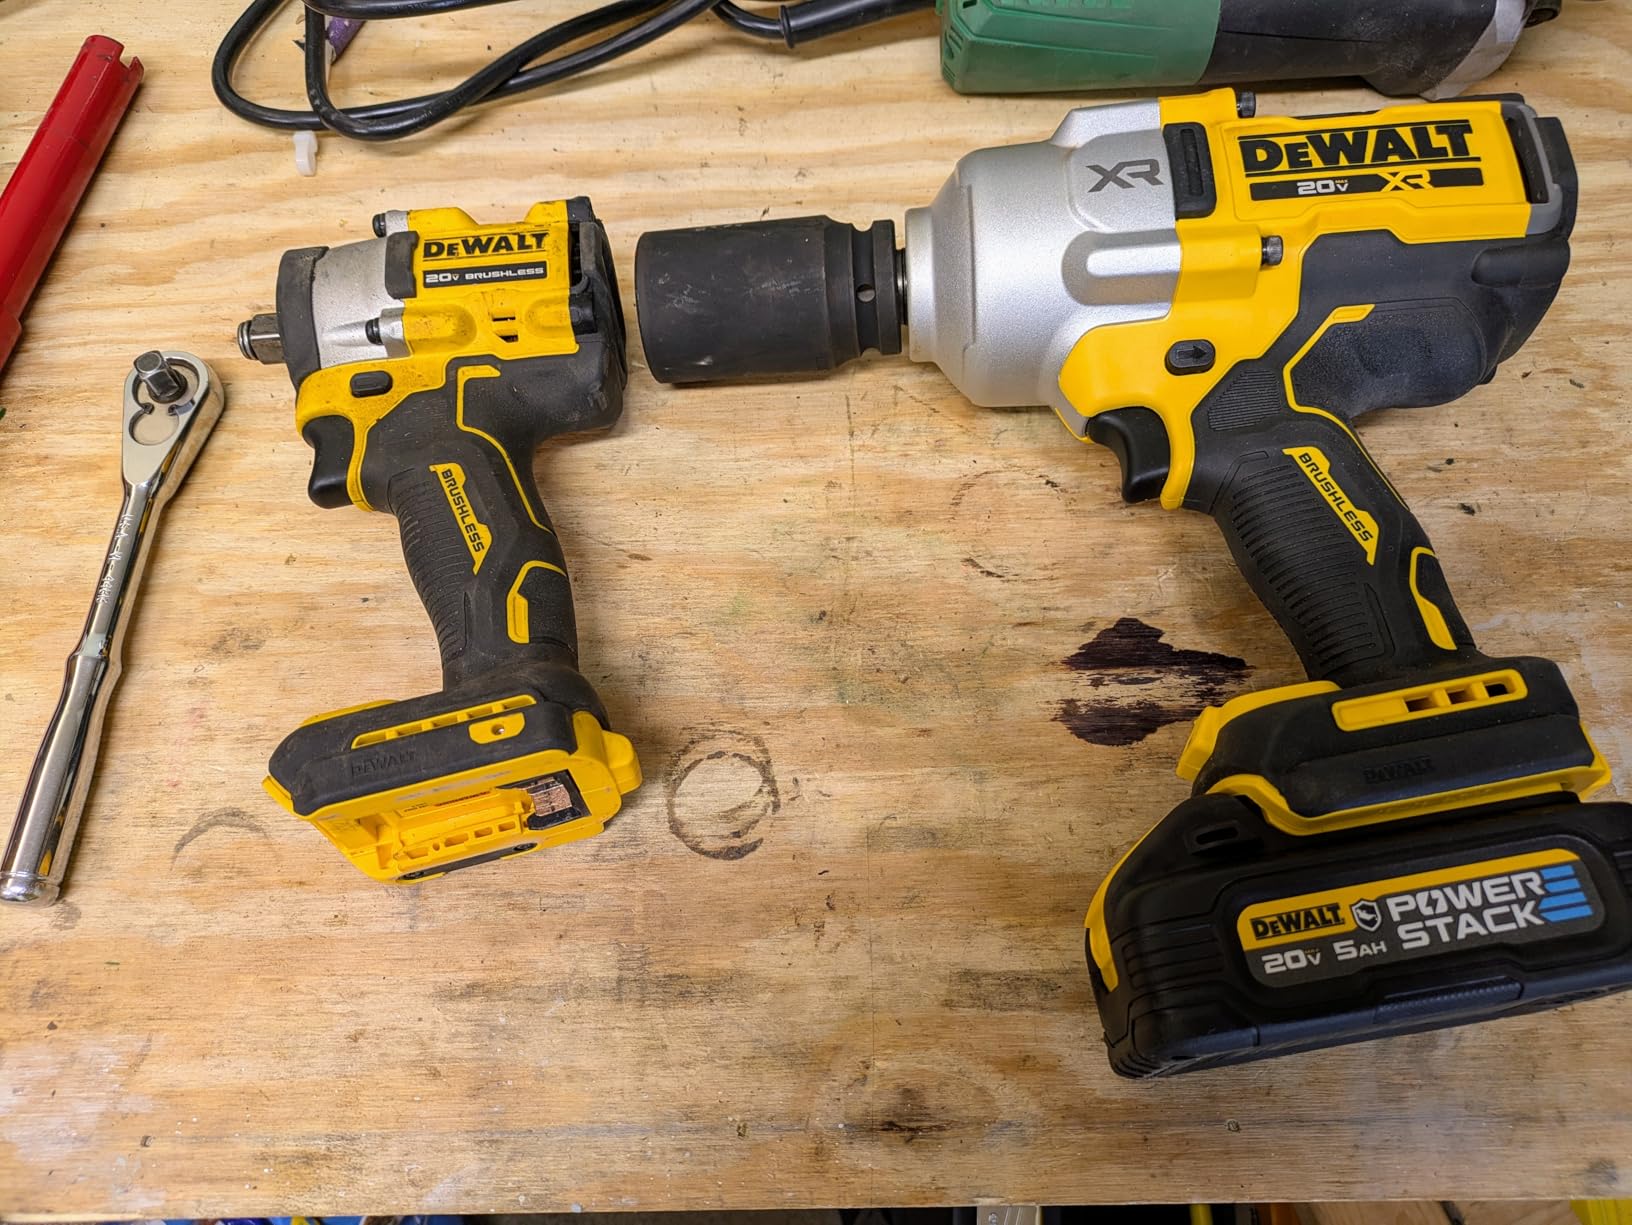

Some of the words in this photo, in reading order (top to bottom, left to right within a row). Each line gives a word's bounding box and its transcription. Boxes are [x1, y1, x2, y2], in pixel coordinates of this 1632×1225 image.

[1085, 158, 1164, 193] XR
[1377, 169, 1434, 192] XR
[465, 267, 544, 281] BRUSHLESS
[441, 468, 485, 553] BRUSHLESS
[1298, 452, 1374, 542] BRUSHLESS
[1386, 871, 1546, 923] POWER
[1397, 900, 1546, 950] STACK
